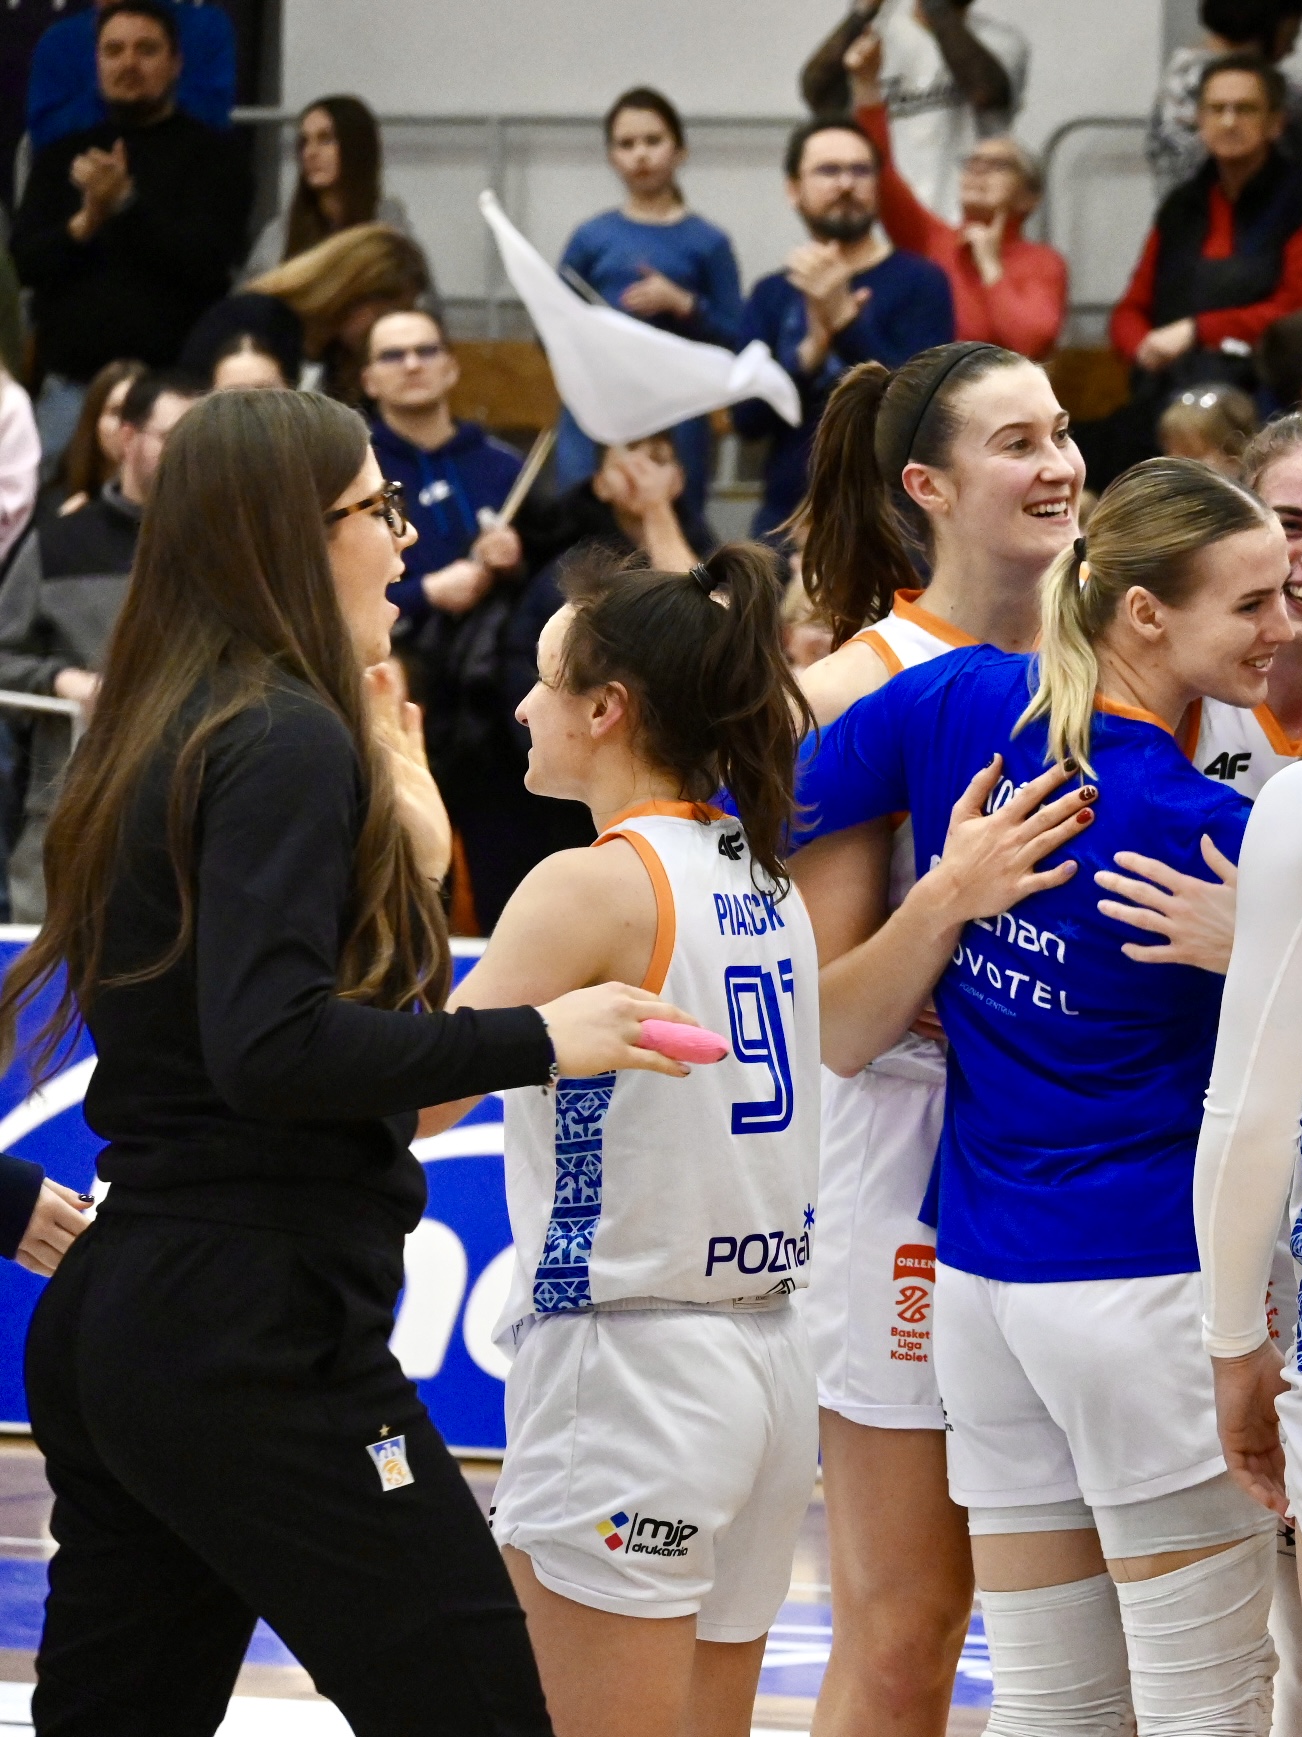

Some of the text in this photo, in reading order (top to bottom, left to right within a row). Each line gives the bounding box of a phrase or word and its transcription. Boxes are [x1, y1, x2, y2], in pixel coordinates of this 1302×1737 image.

[1203, 751, 1252, 780] 4F
[896, 1257, 936, 1269] ORLEN
[890, 1327, 930, 1340] Basket
[897, 1339, 922, 1351] Liga
[890, 1350, 929, 1363] Kobiet
[636, 1517, 699, 1548] mjp
